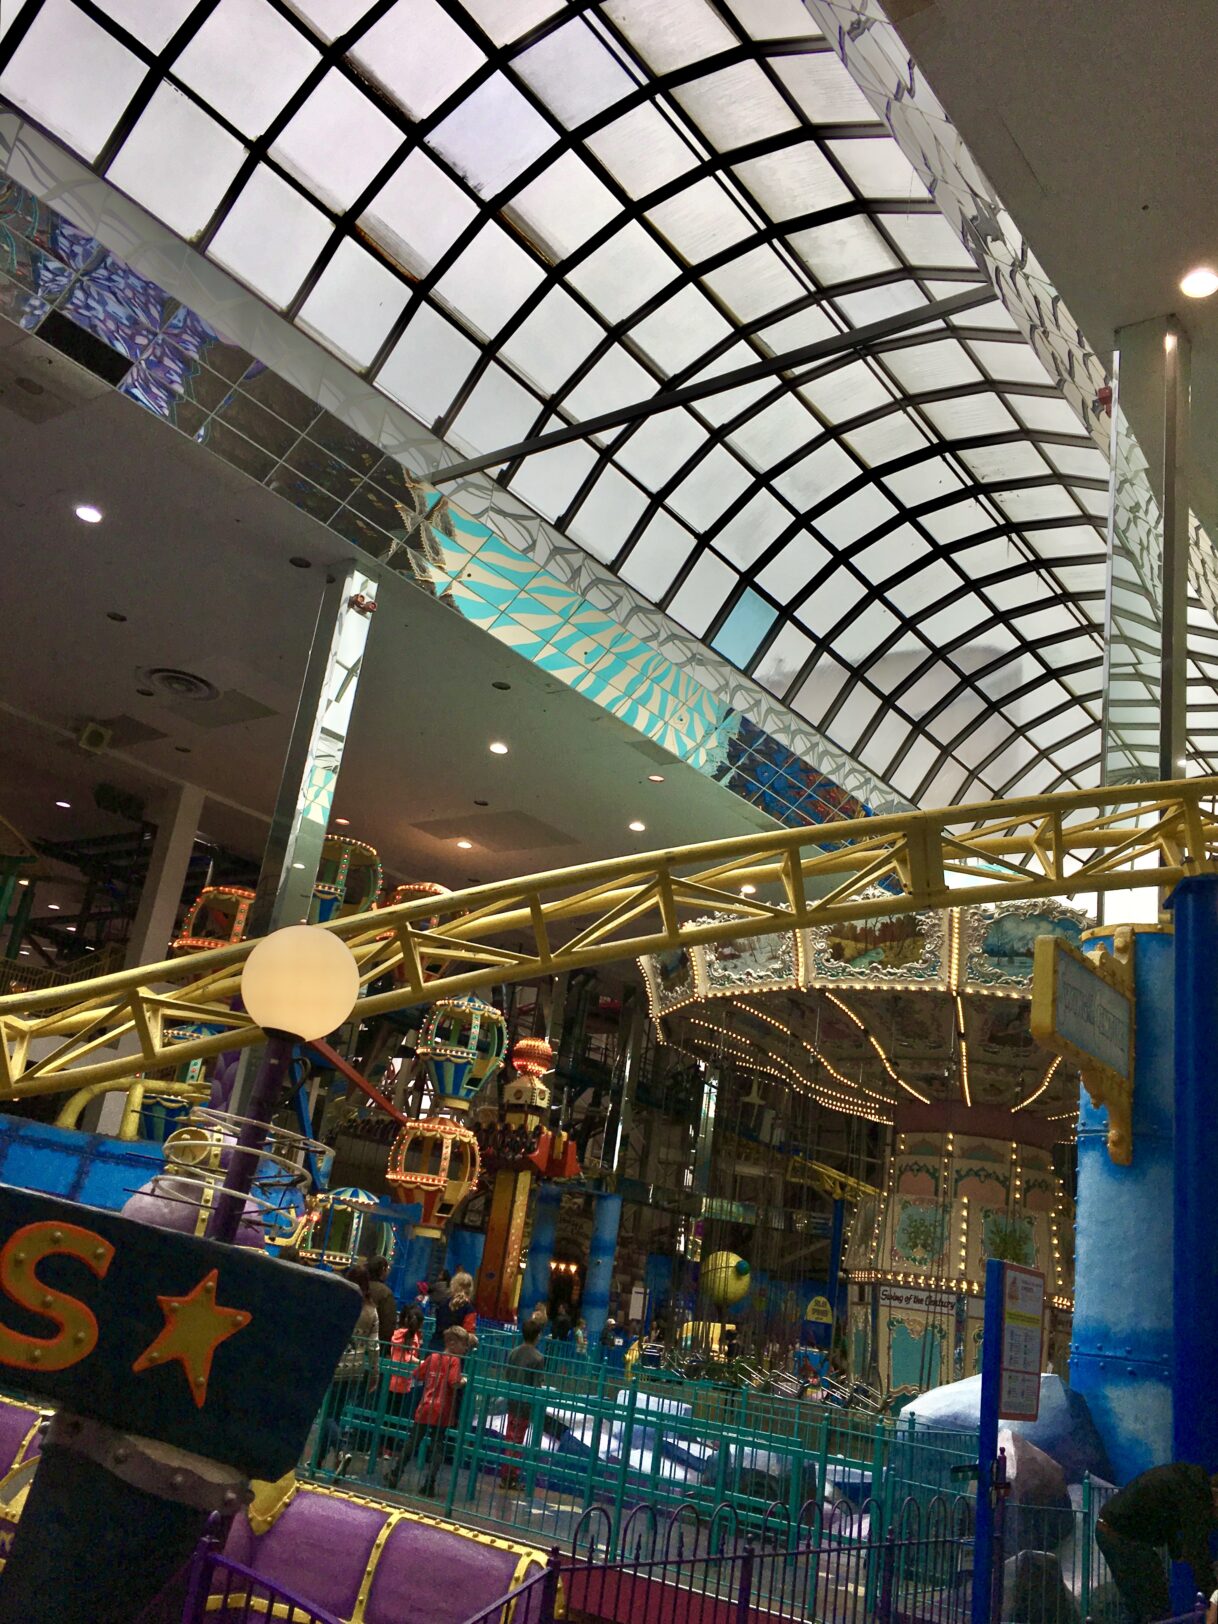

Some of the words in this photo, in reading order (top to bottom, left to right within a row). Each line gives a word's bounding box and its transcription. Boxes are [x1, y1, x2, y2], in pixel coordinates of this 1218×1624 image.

[0, 1220, 116, 1372] S
[881, 1289, 905, 1304] Swing
[904, 1294, 913, 1304] of
[914, 1294, 924, 1304] the
[925, 1294, 955, 1310] Century
